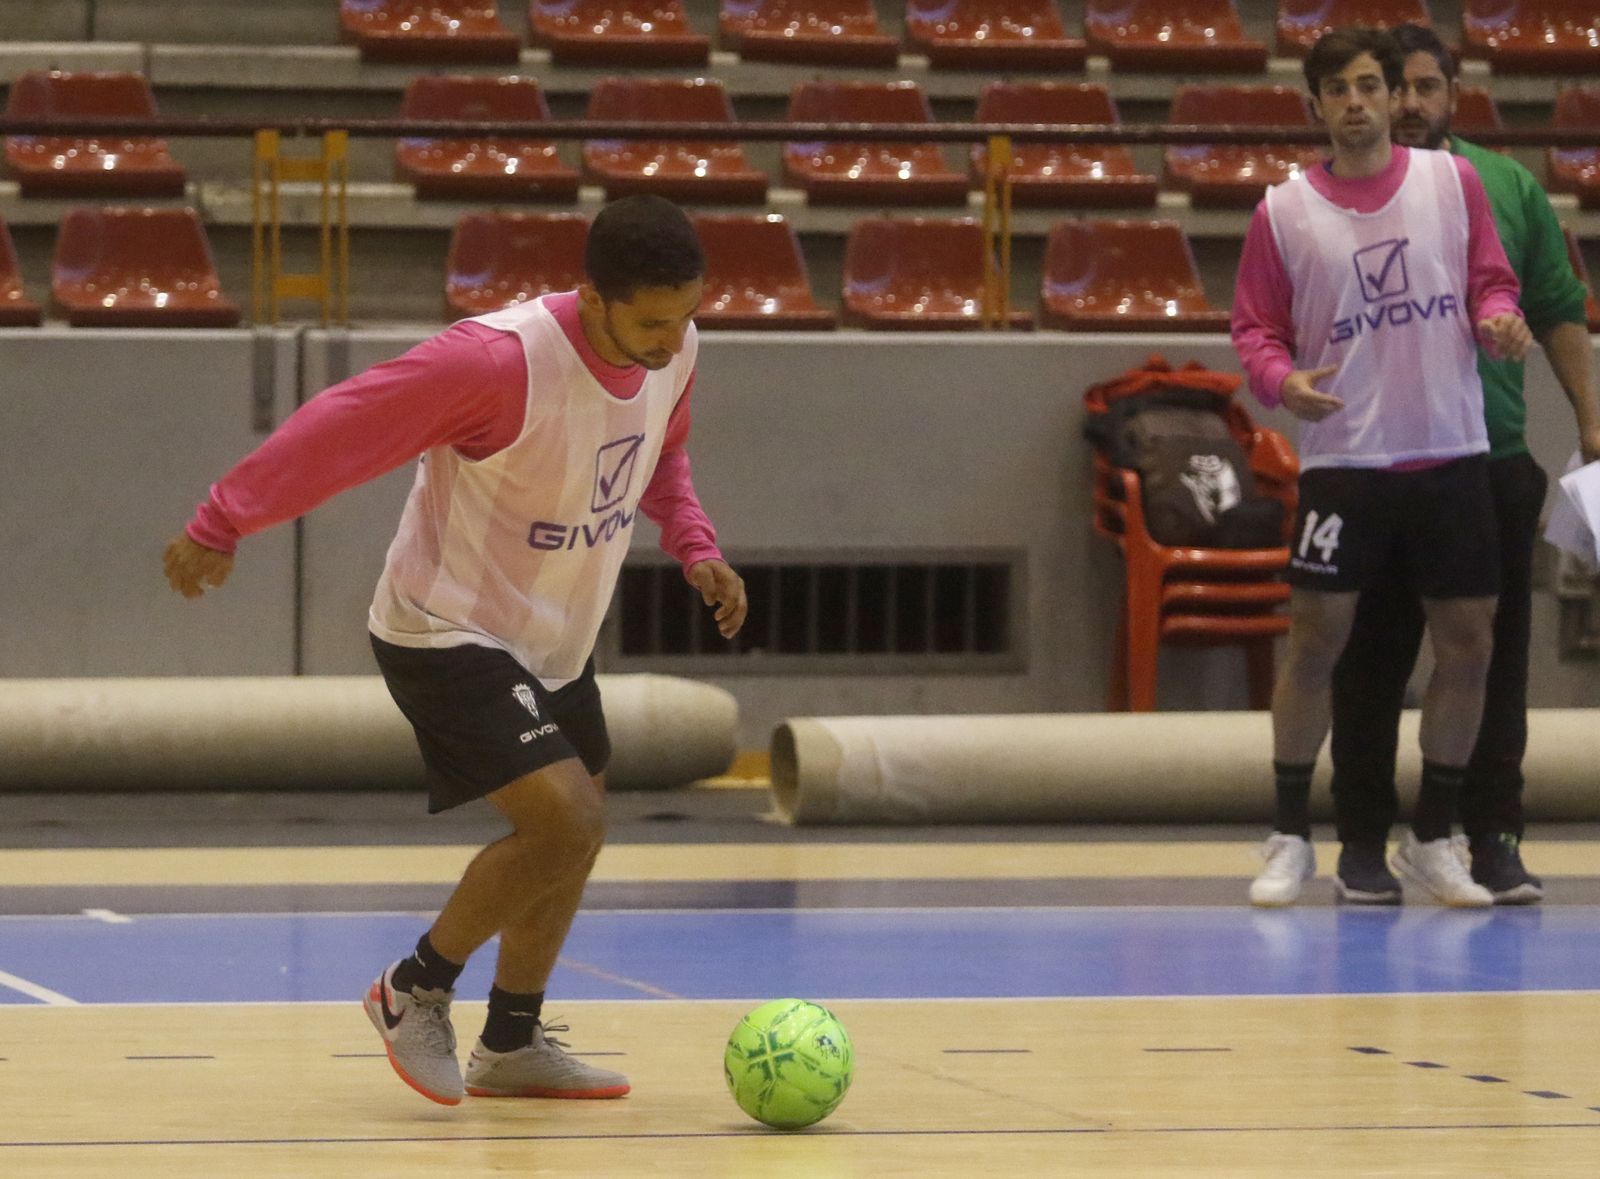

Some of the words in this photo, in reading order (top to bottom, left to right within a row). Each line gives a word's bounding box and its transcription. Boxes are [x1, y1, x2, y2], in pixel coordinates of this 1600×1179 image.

[1329, 294, 1458, 345] GIVOVA
[527, 503, 638, 550] GIVOV
[1299, 510, 1344, 564] 14
